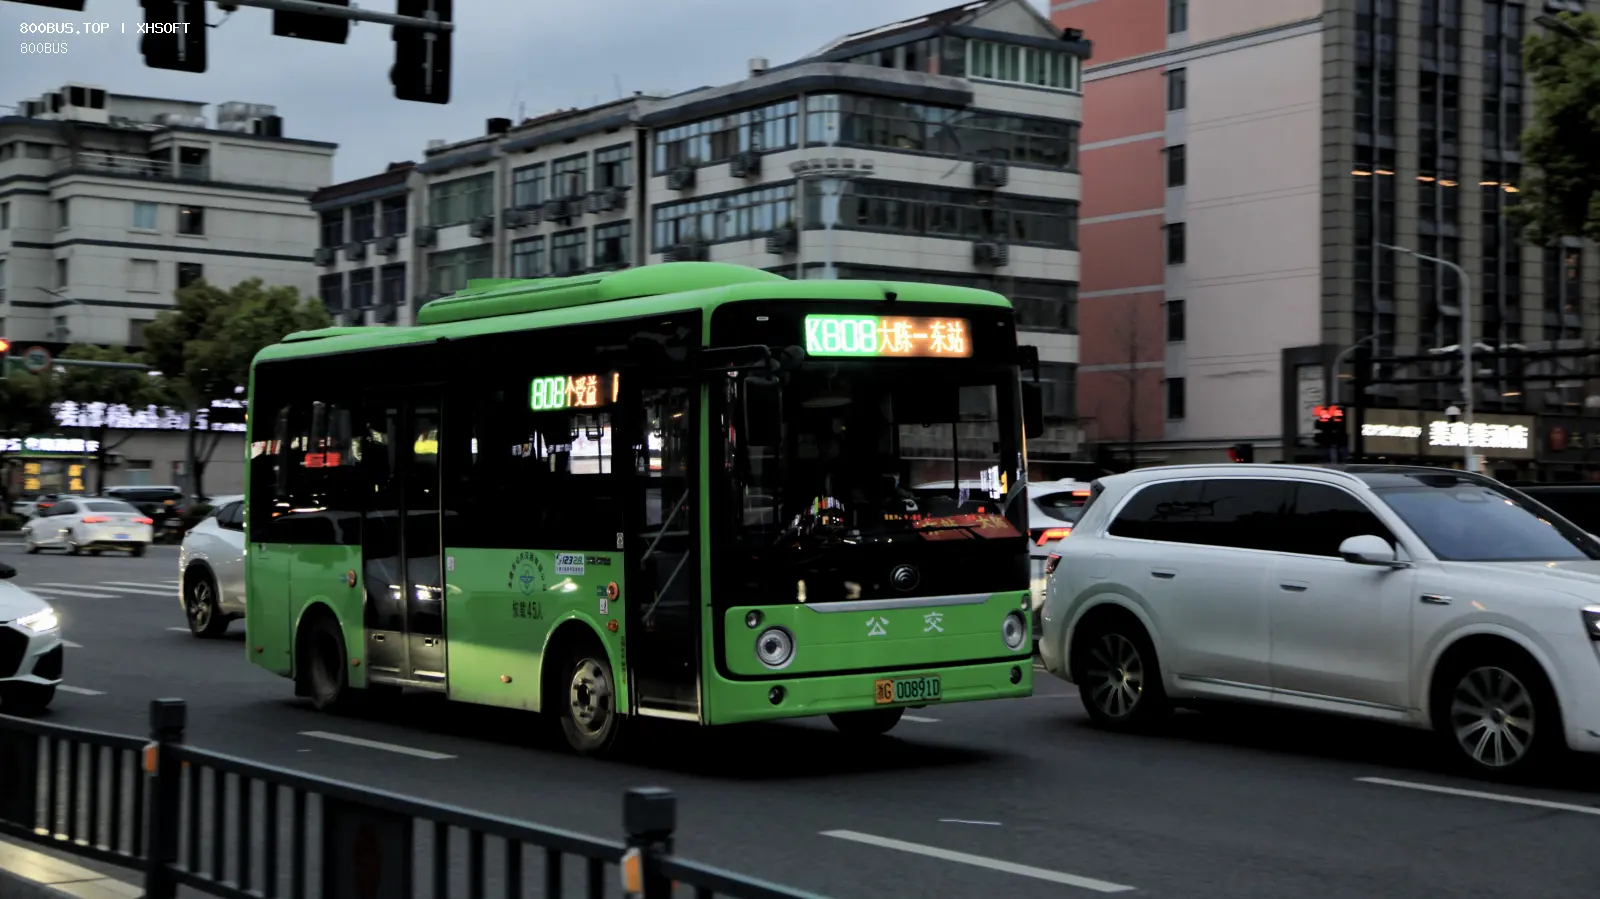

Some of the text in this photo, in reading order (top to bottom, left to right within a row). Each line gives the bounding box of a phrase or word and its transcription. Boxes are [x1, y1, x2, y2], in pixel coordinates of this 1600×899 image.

[804, 318, 877, 353] K808
[531, 376, 565, 410] 808
[896, 678, 940, 699] 00891D
